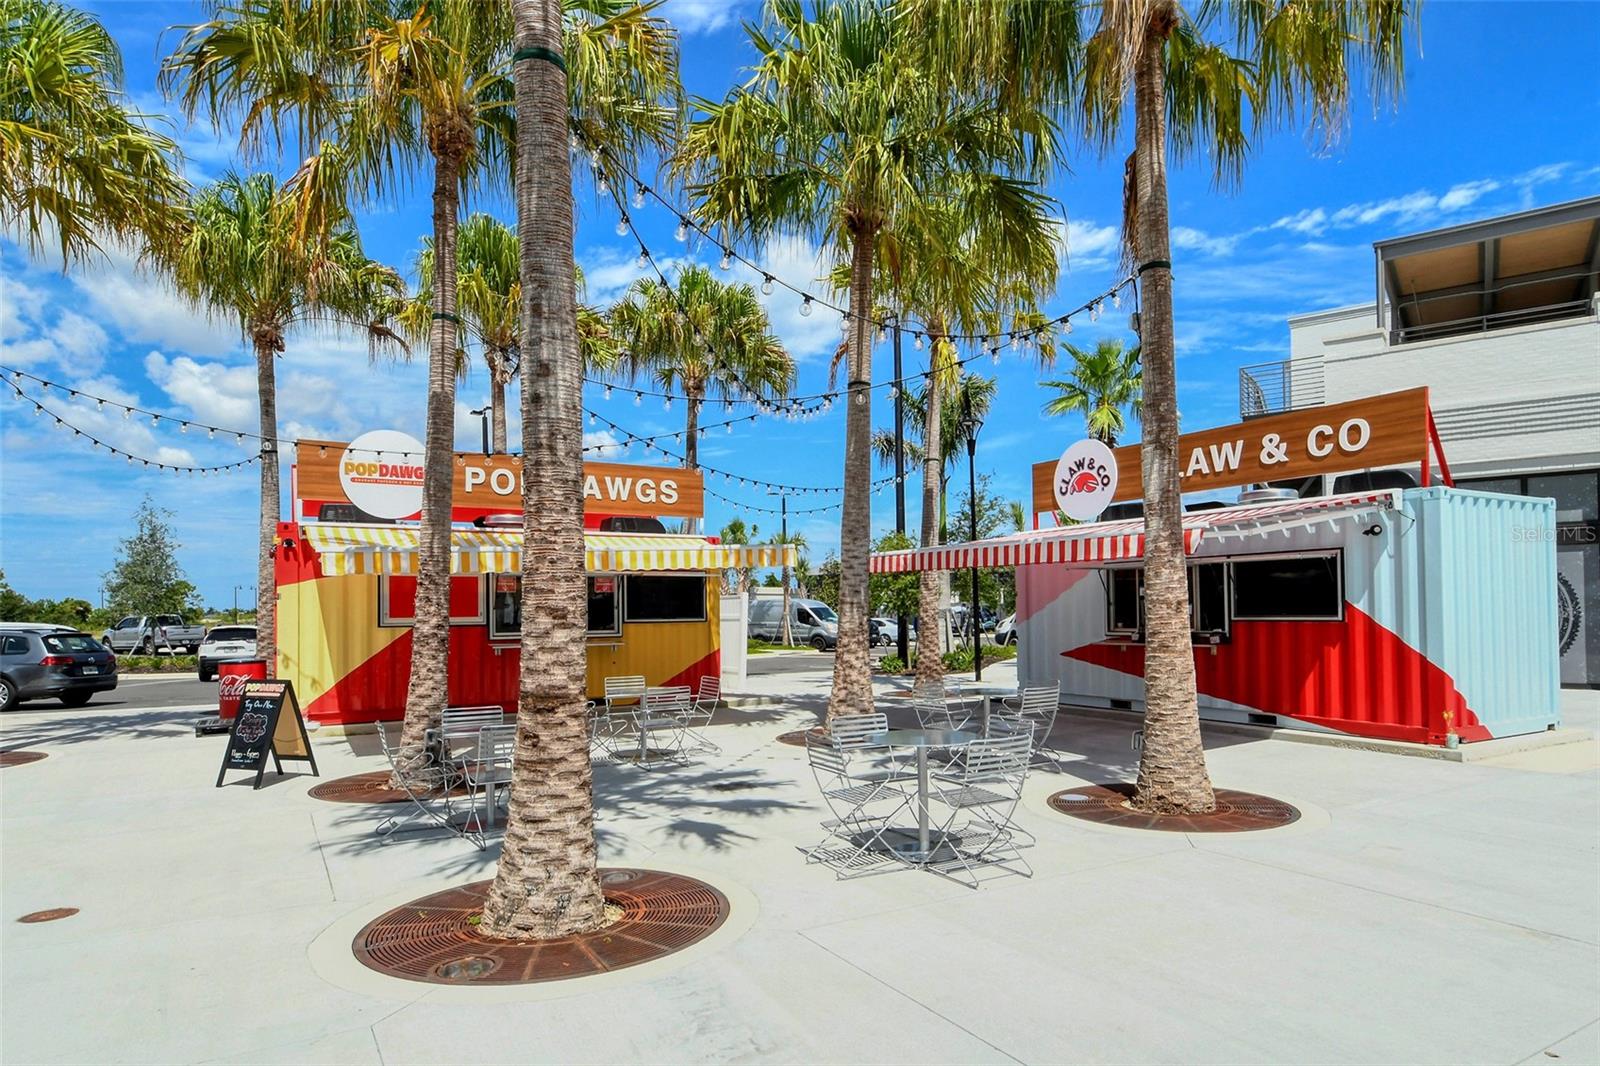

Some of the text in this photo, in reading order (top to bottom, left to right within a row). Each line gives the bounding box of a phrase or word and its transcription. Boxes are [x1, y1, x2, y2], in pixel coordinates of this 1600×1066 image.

[1259, 433, 1290, 465] &
[1306, 417, 1371, 457] CO
[344, 461, 424, 480] POPDAWG
[464, 466, 679, 505] PO AWGS
